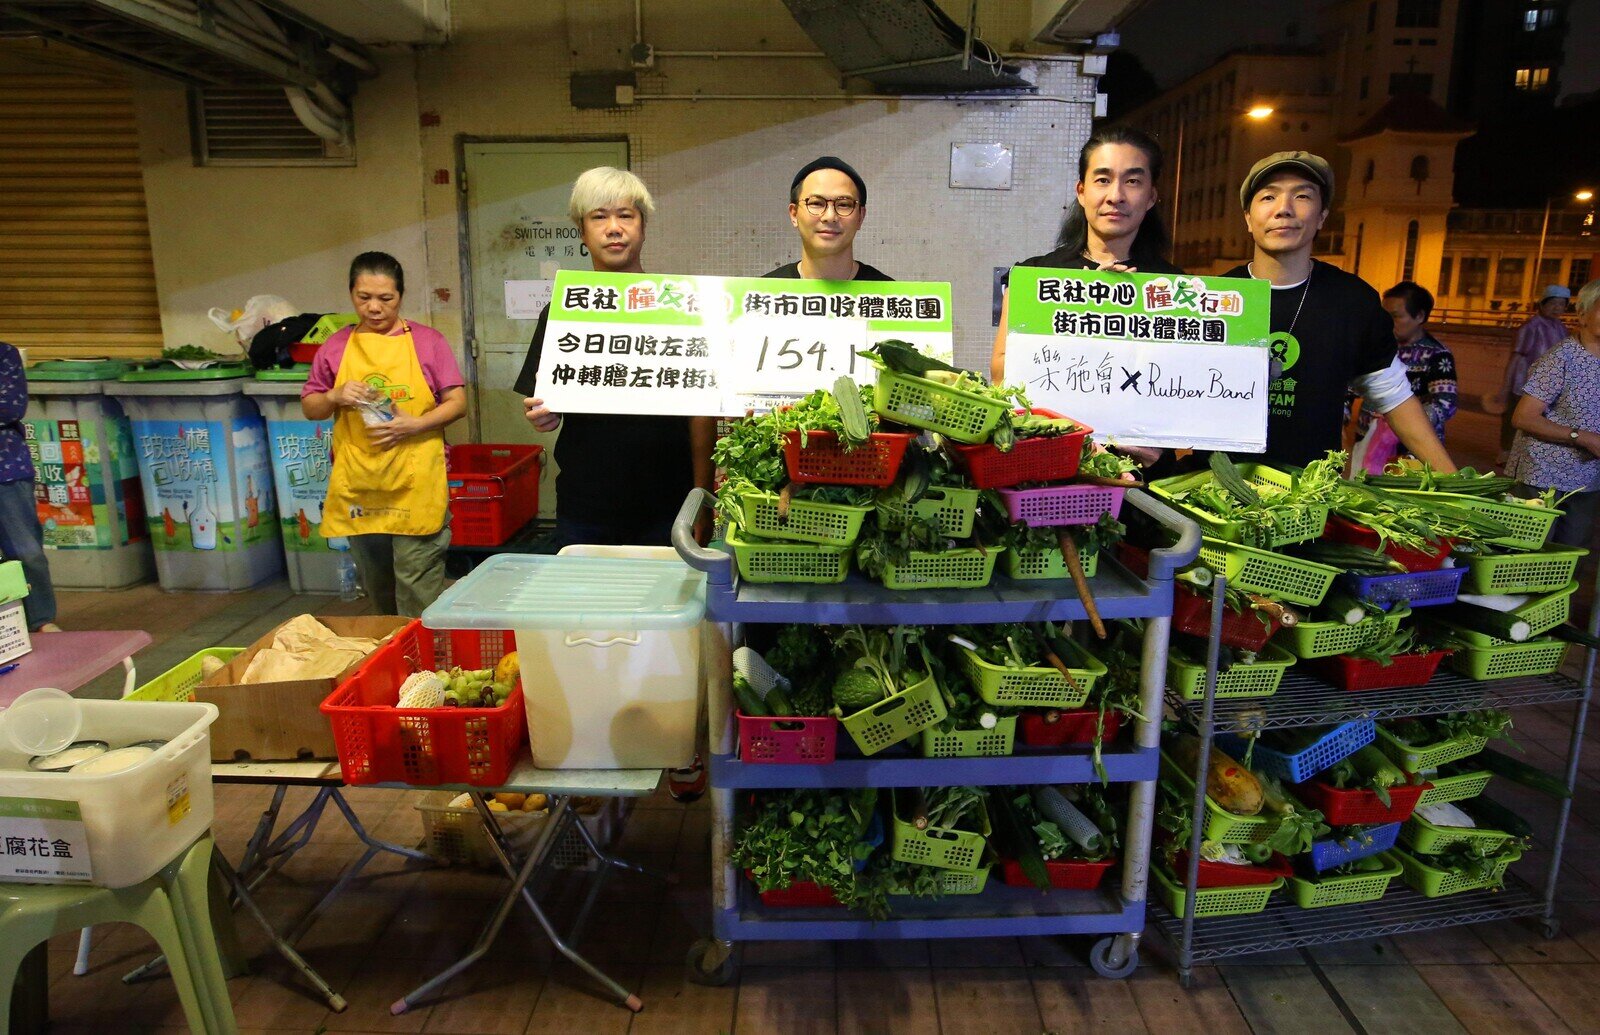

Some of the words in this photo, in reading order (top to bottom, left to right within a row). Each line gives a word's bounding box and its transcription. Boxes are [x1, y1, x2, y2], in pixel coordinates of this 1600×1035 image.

[514, 228, 552, 239] SWITCH
[564, 287, 618, 310] 民社
[745, 293, 942, 319] 街市回收體驗團
[1038, 279, 1136, 306] 民社中心
[1145, 279, 1240, 313] 糧友行動
[1053, 311, 1226, 343] 街市回收體驗團
[1029, 344, 1115, 395] 樂施會
[1268, 394, 1296, 407] FAM
[150, 459, 219, 488] 回收桶
[0, 836, 74, 859] 腐花盒
